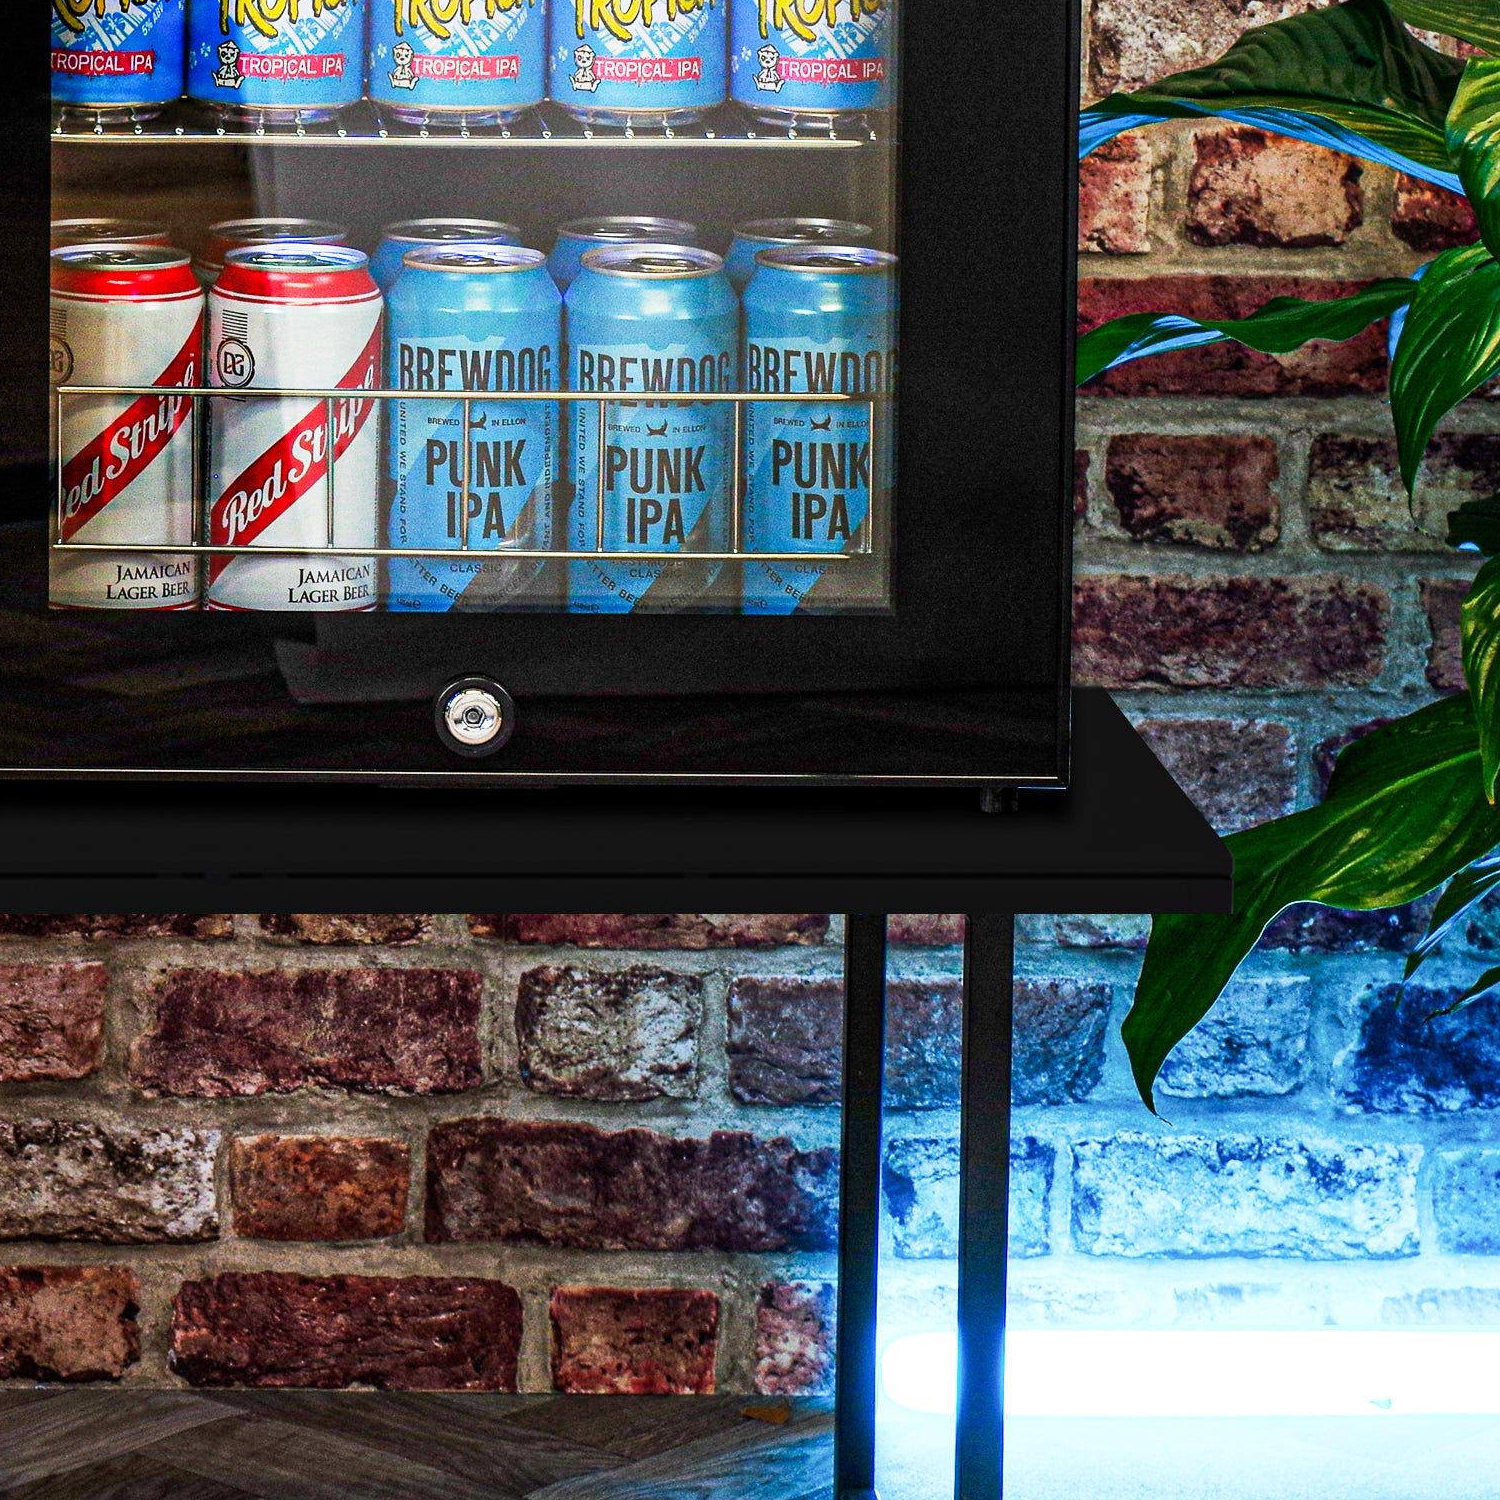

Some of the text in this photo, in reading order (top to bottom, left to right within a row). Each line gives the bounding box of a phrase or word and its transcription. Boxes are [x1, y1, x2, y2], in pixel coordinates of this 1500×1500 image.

[141, 1, 164, 36] 5% ABV
[51, 52, 153, 72] TROPICAL IPA
[240, 56, 343, 75] TROPICAL IPA
[414, 56, 518, 76] TROPICAL IPA
[595, 59, 700, 78] TROPICAL IPA
[780, 61, 885, 80] TROPICAL IPA
[400, 343, 551, 391] BREWDOG
[579, 349, 730, 408] BREWDOG
[426, 417, 526, 427] BREWED IN ELLON
[578, 407, 586, 451] UNITED
[607, 423, 641, 433] BREWED
[773, 417, 805, 427] BREWED
[60, 361, 194, 527] ed Stripe
[399, 451, 407, 469] WE
[426, 438, 527, 488] PUNK
[578, 456, 586, 474] WE
[606, 445, 706, 494] PUNK
[771, 438, 870, 489] PUNK
[222, 459, 288, 545] Red
[399, 474, 407, 514] STAND
[578, 479, 586, 518] STAND
[446, 491, 506, 539] IPA
[626, 498, 686, 545] IPA
[791, 492, 850, 540] IPA
[399, 518, 408, 544] FOR
[578, 522, 586, 547] FOR
[115, 561, 191, 585] JAMAICAN
[296, 564, 371, 588] JAMAICAN
[449, 563, 503, 573] CLASSIC
[586, 560, 616, 591] ETTER
[629, 568, 682, 579] CLASSIC
[106, 581, 190, 600] LAGER BEER
[288, 584, 370, 603] LAGER BEER
